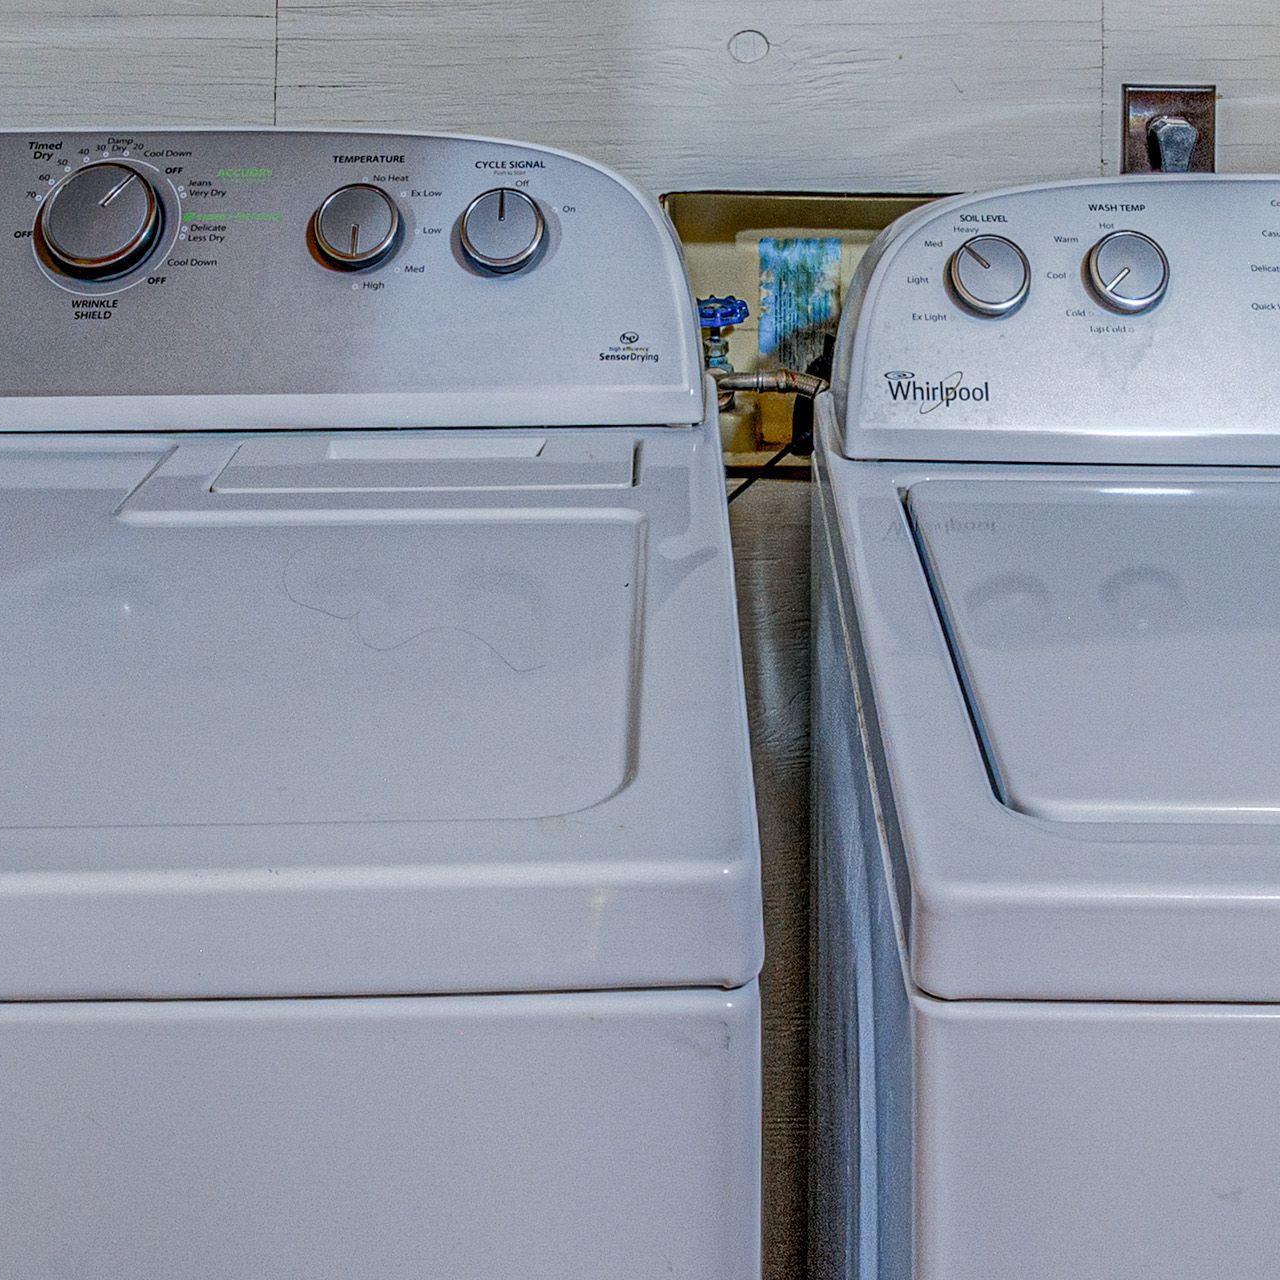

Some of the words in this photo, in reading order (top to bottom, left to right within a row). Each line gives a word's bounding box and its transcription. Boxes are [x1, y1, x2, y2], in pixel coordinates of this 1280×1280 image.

[28, 141, 62, 151] Timed
[107, 137, 133, 146] Damp
[133, 142, 144, 150] 20
[78, 148, 89, 156] 40
[111, 144, 127, 152] Dry
[33, 151, 53, 162] Dry
[144, 149, 164, 158] Cool
[166, 149, 191, 158] Down
[57, 158, 67, 166] 50
[332, 154, 406, 164] TEMPERATURE
[475, 160, 507, 169] CYCLE
[509, 160, 546, 169] SIGNAL
[165, 166, 182, 175] OFF
[39, 174, 50, 182] 60
[373, 174, 386, 182] No
[388, 174, 409, 182] Heat
[188, 179, 212, 187] Jeans
[515, 179, 530, 188] Off
[25, 191, 36, 199] 70
[189, 189, 207, 199] Very
[210, 189, 226, 198] Dry
[411, 189, 421, 197] Ex
[423, 189, 442, 197] Low
[563, 205, 576, 214] On
[1088, 204, 1117, 212] WASH
[1119, 204, 1146, 212] TEMP
[959, 214, 980, 223] SOIL
[981, 214, 1008, 223] LEVEL
[190, 223, 227, 232] Delicate
[953, 225, 979, 235] Heavy
[1099, 221, 1115, 230] Hot
[13, 230, 33, 239] OFF
[423, 226, 442, 235] Low
[188, 233, 207, 242] Less
[210, 233, 226, 243] Dry
[1053, 235, 1078, 244] Warm
[924, 240, 943, 248] Med
[167, 258, 187, 267] Cool
[190, 258, 217, 267] Down
[404, 265, 425, 273] Med
[1047, 271, 1067, 280] Cool
[147, 276, 166, 285] OFF
[906, 276, 929, 286] Light
[362, 281, 384, 291] High
[71, 299, 118, 309] WRINKLE
[1251, 302, 1275, 312] Quick
[74, 310, 112, 320] SHIELD
[912, 313, 922, 321] Ex
[925, 312, 947, 323] Light
[1065, 309, 1086, 318] Cold
[599, 352, 659, 363] SensorDrying
[887, 380, 990, 408] Whirlpool
